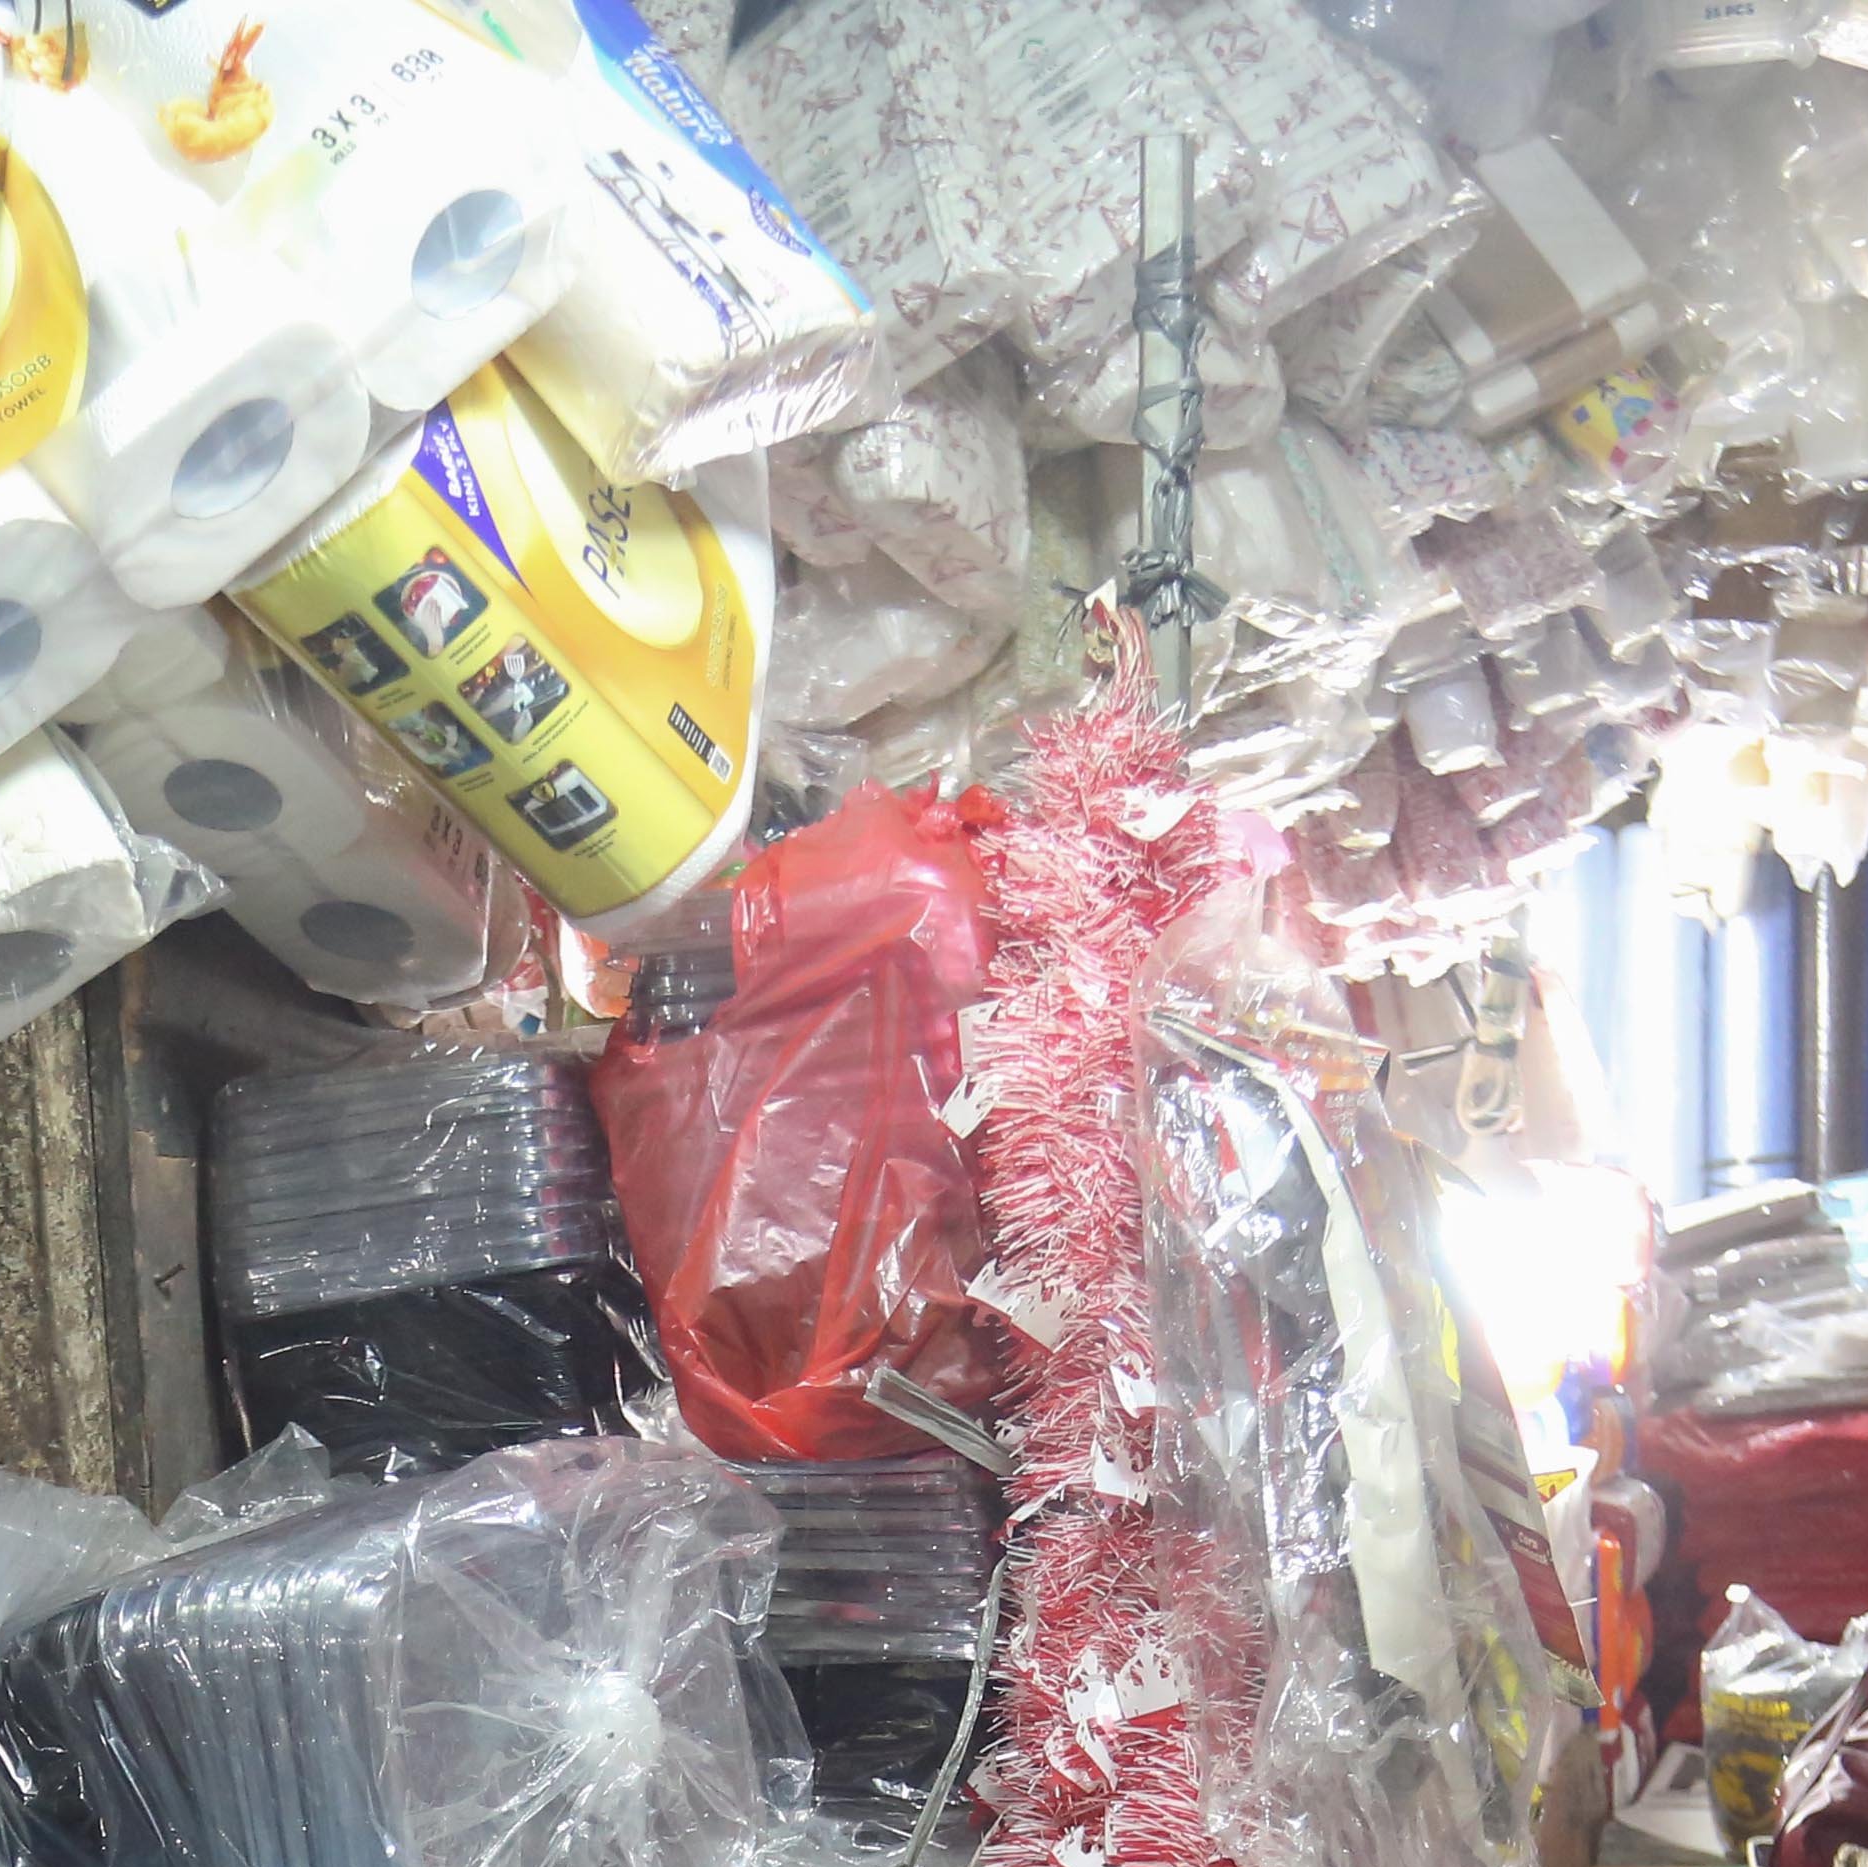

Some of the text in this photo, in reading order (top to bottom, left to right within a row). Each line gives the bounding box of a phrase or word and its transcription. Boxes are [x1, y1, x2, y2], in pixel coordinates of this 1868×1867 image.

[312, 127, 338, 150] 3
[459, 473, 480, 517] KINI
[582, 484, 633, 600] PASE
